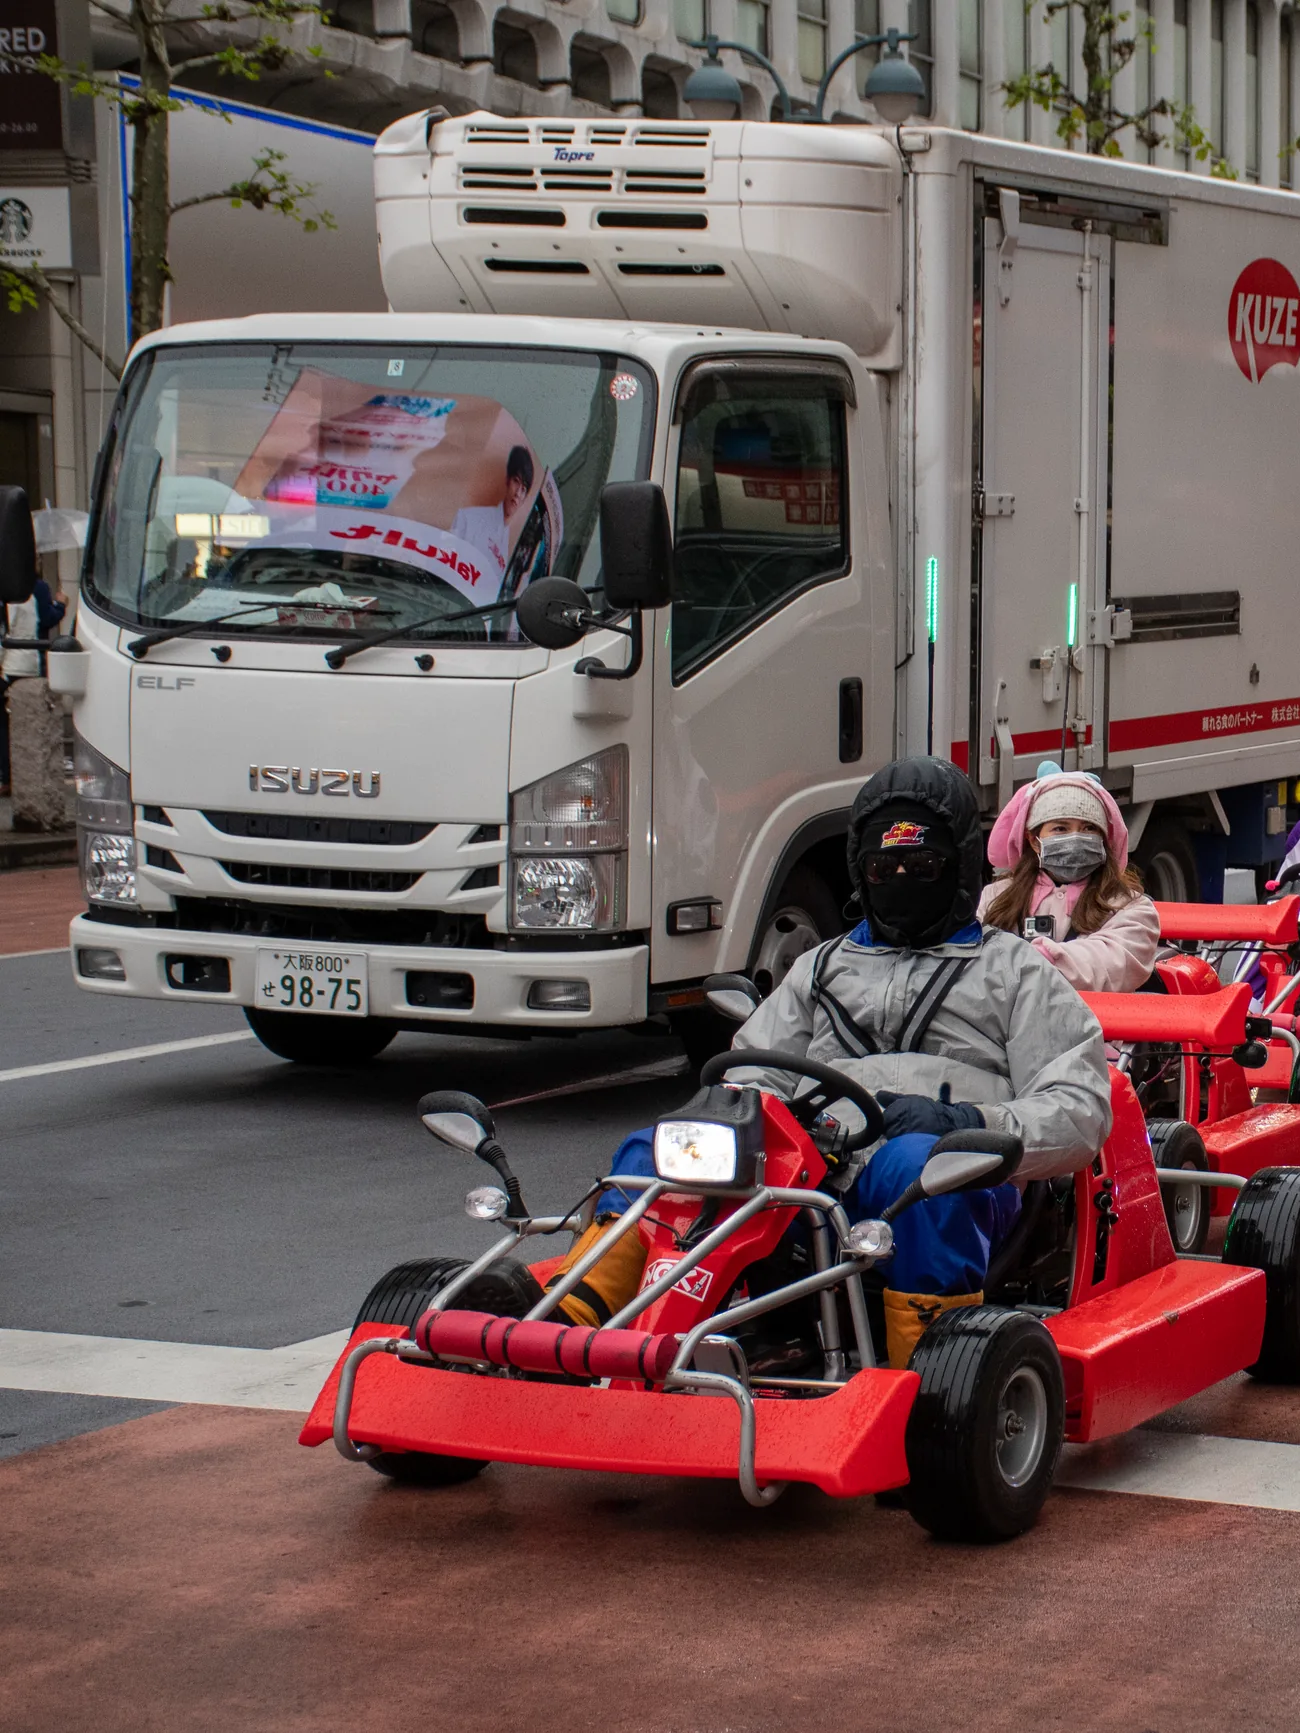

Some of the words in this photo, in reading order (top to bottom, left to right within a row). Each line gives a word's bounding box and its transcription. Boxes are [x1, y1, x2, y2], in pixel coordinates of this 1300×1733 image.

[553, 146, 595, 163] Topre
[1235, 291, 1299, 378] KUZE
[137, 676, 195, 690] ELF
[1202, 711, 1263, 732] 頼れる食のパートナー
[249, 764, 381, 798] ISUZU
[262, 982, 277, 998] せ
[280, 974, 361, 1011] 98-75
